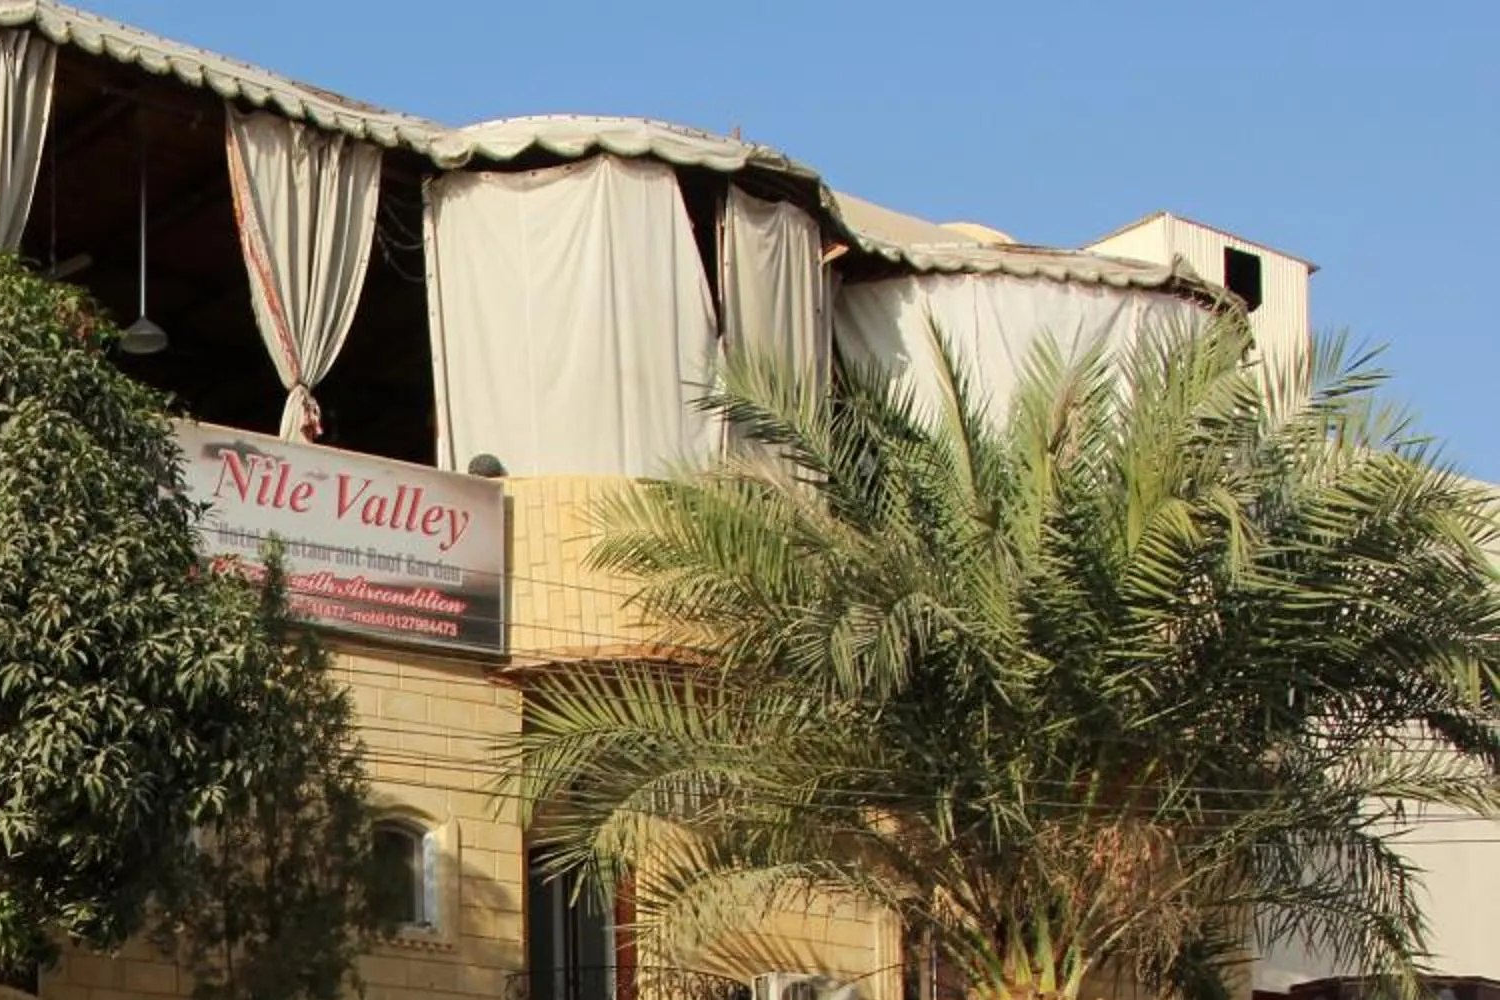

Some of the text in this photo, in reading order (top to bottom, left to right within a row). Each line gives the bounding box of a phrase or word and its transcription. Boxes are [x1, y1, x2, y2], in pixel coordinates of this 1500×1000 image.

[213, 449, 471, 551] Nile Valley
[406, 554, 461, 583] Garden
